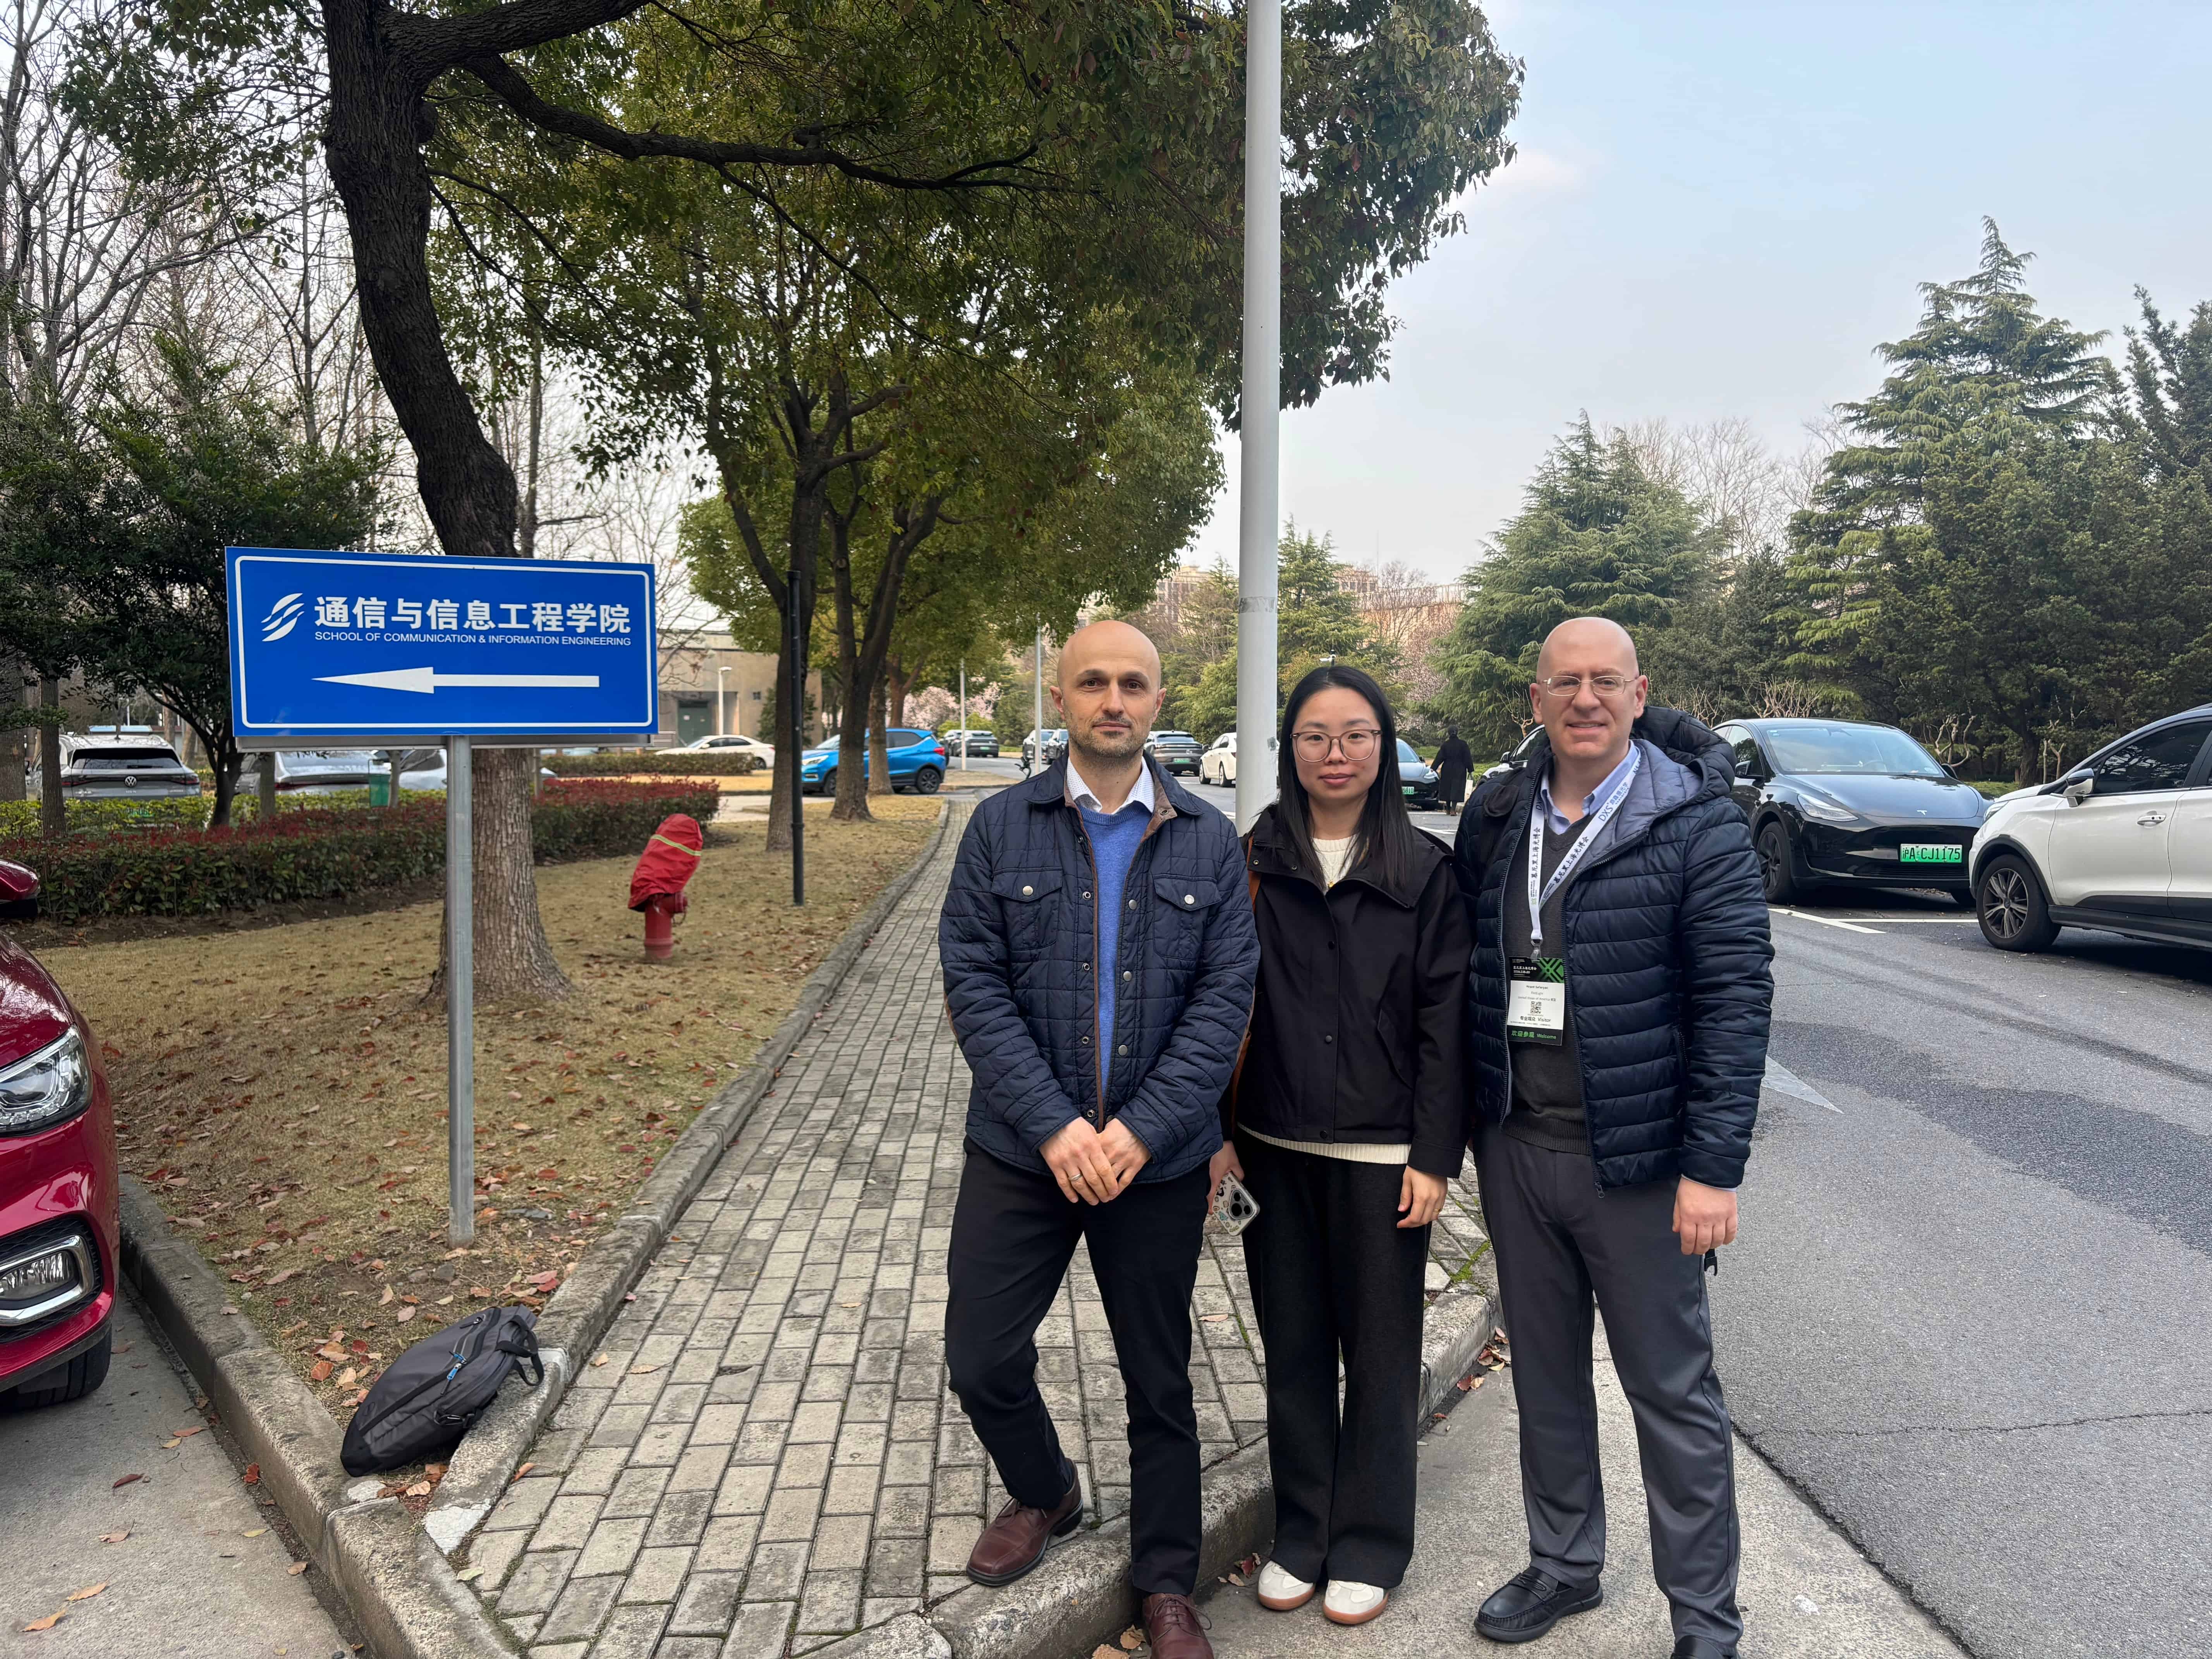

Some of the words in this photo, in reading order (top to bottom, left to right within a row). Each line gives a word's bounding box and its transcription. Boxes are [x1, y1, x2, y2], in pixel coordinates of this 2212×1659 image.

[314, 596, 631, 633] 通信与信息工程学院
[315, 632, 363, 641] SCHOOL
[366, 633, 381, 641] OF
[384, 633, 476, 643] COMMUNICATION
[489, 635, 559, 644] INFORMATION
[562, 637, 631, 646] ENGINEERING
